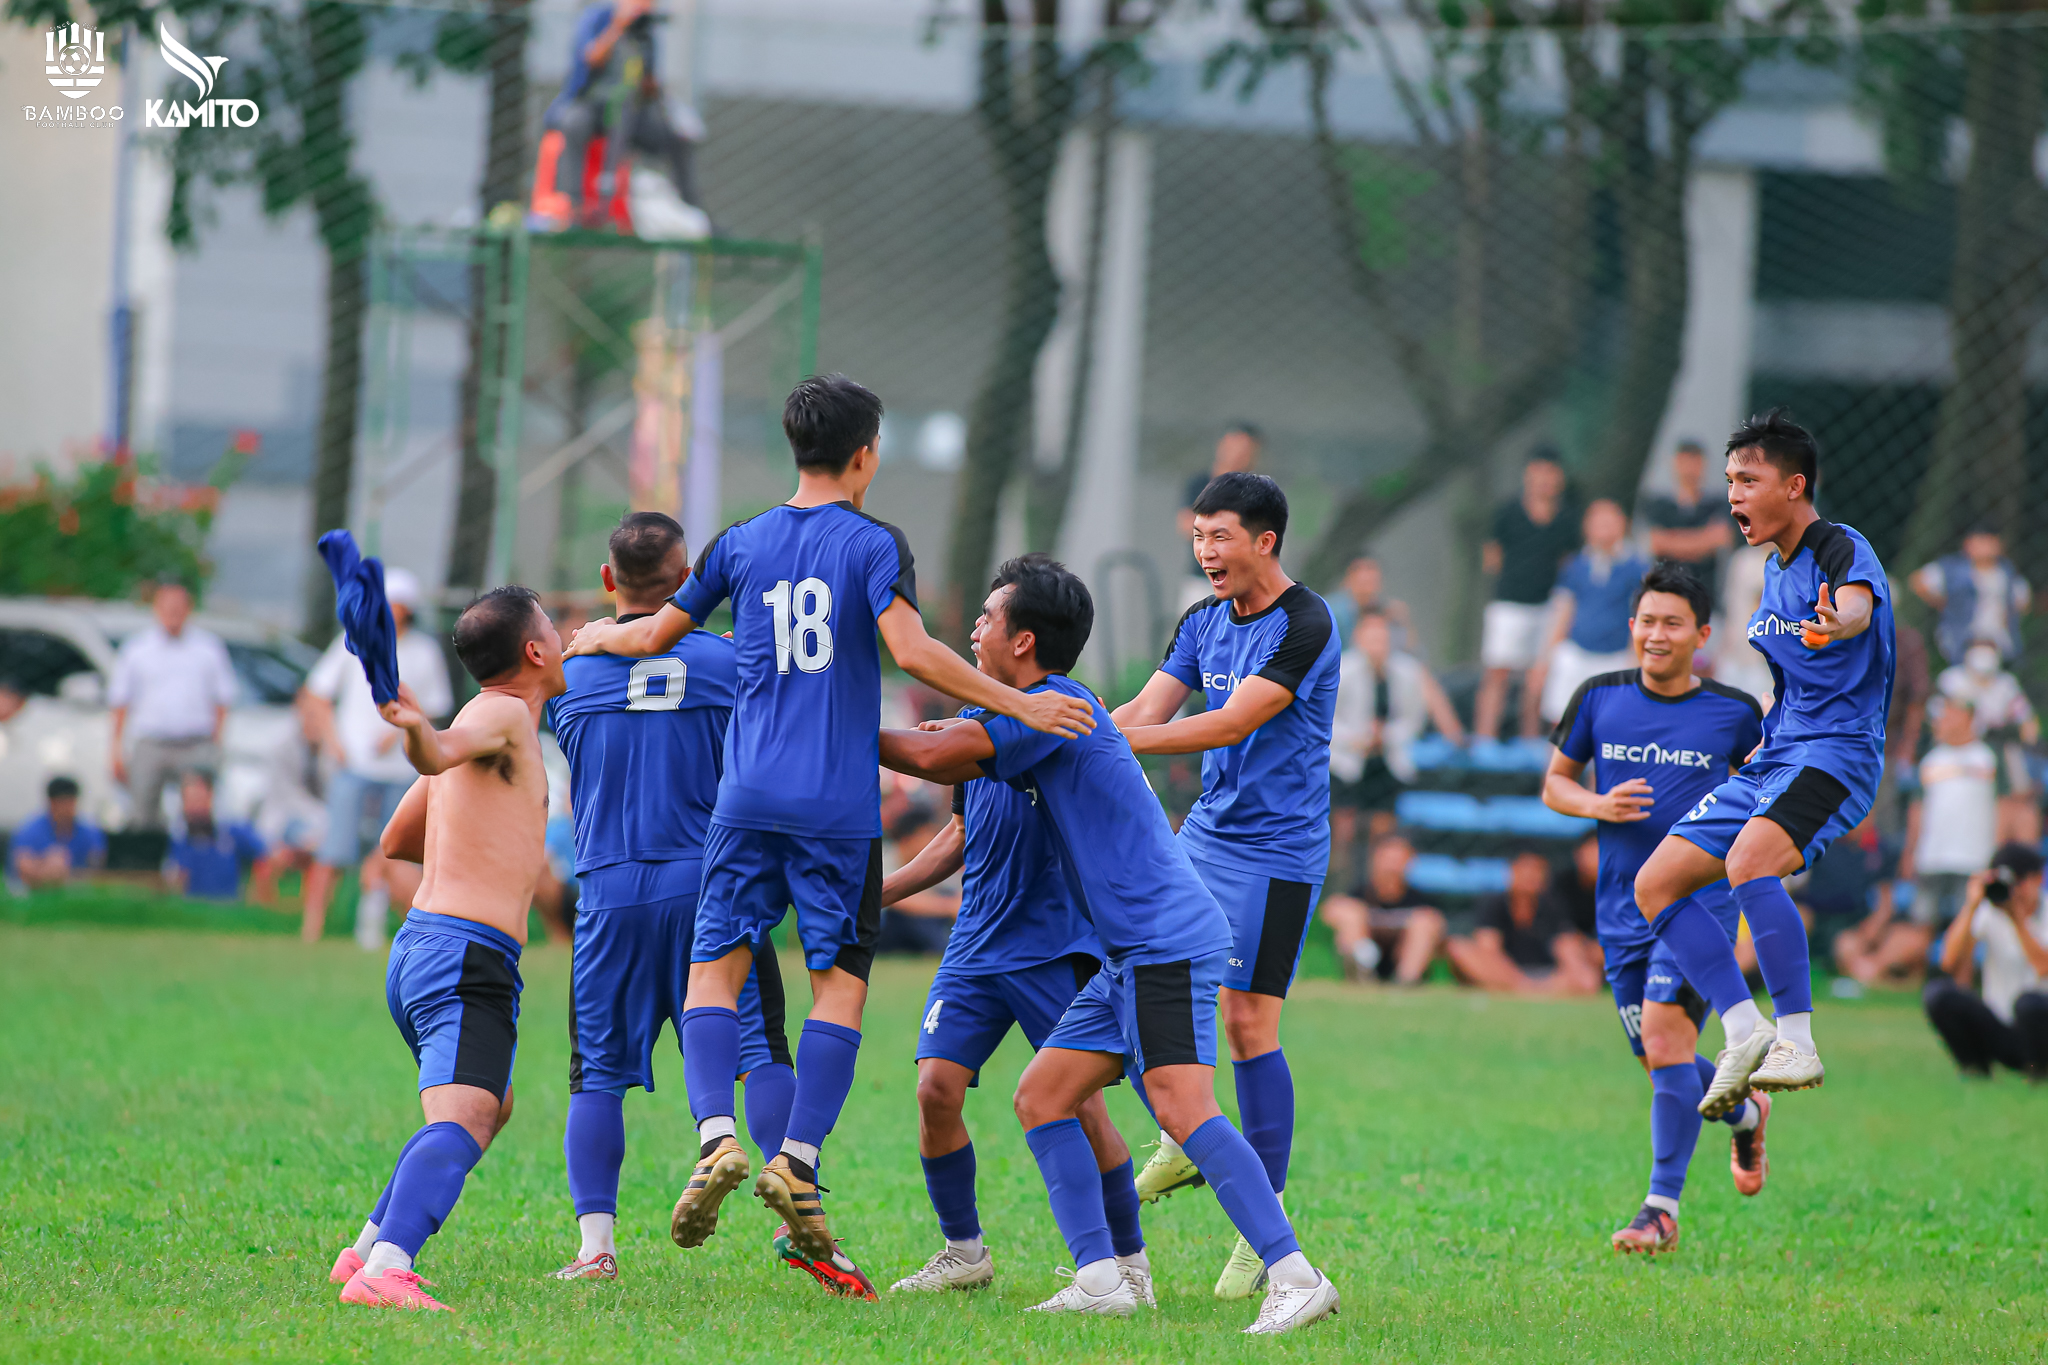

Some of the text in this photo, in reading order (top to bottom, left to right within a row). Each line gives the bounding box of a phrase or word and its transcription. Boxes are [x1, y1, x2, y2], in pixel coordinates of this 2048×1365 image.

[762, 577, 834, 675] 18
[1601, 742, 1713, 770] BECAMEX
[923, 999, 945, 1035] 4
